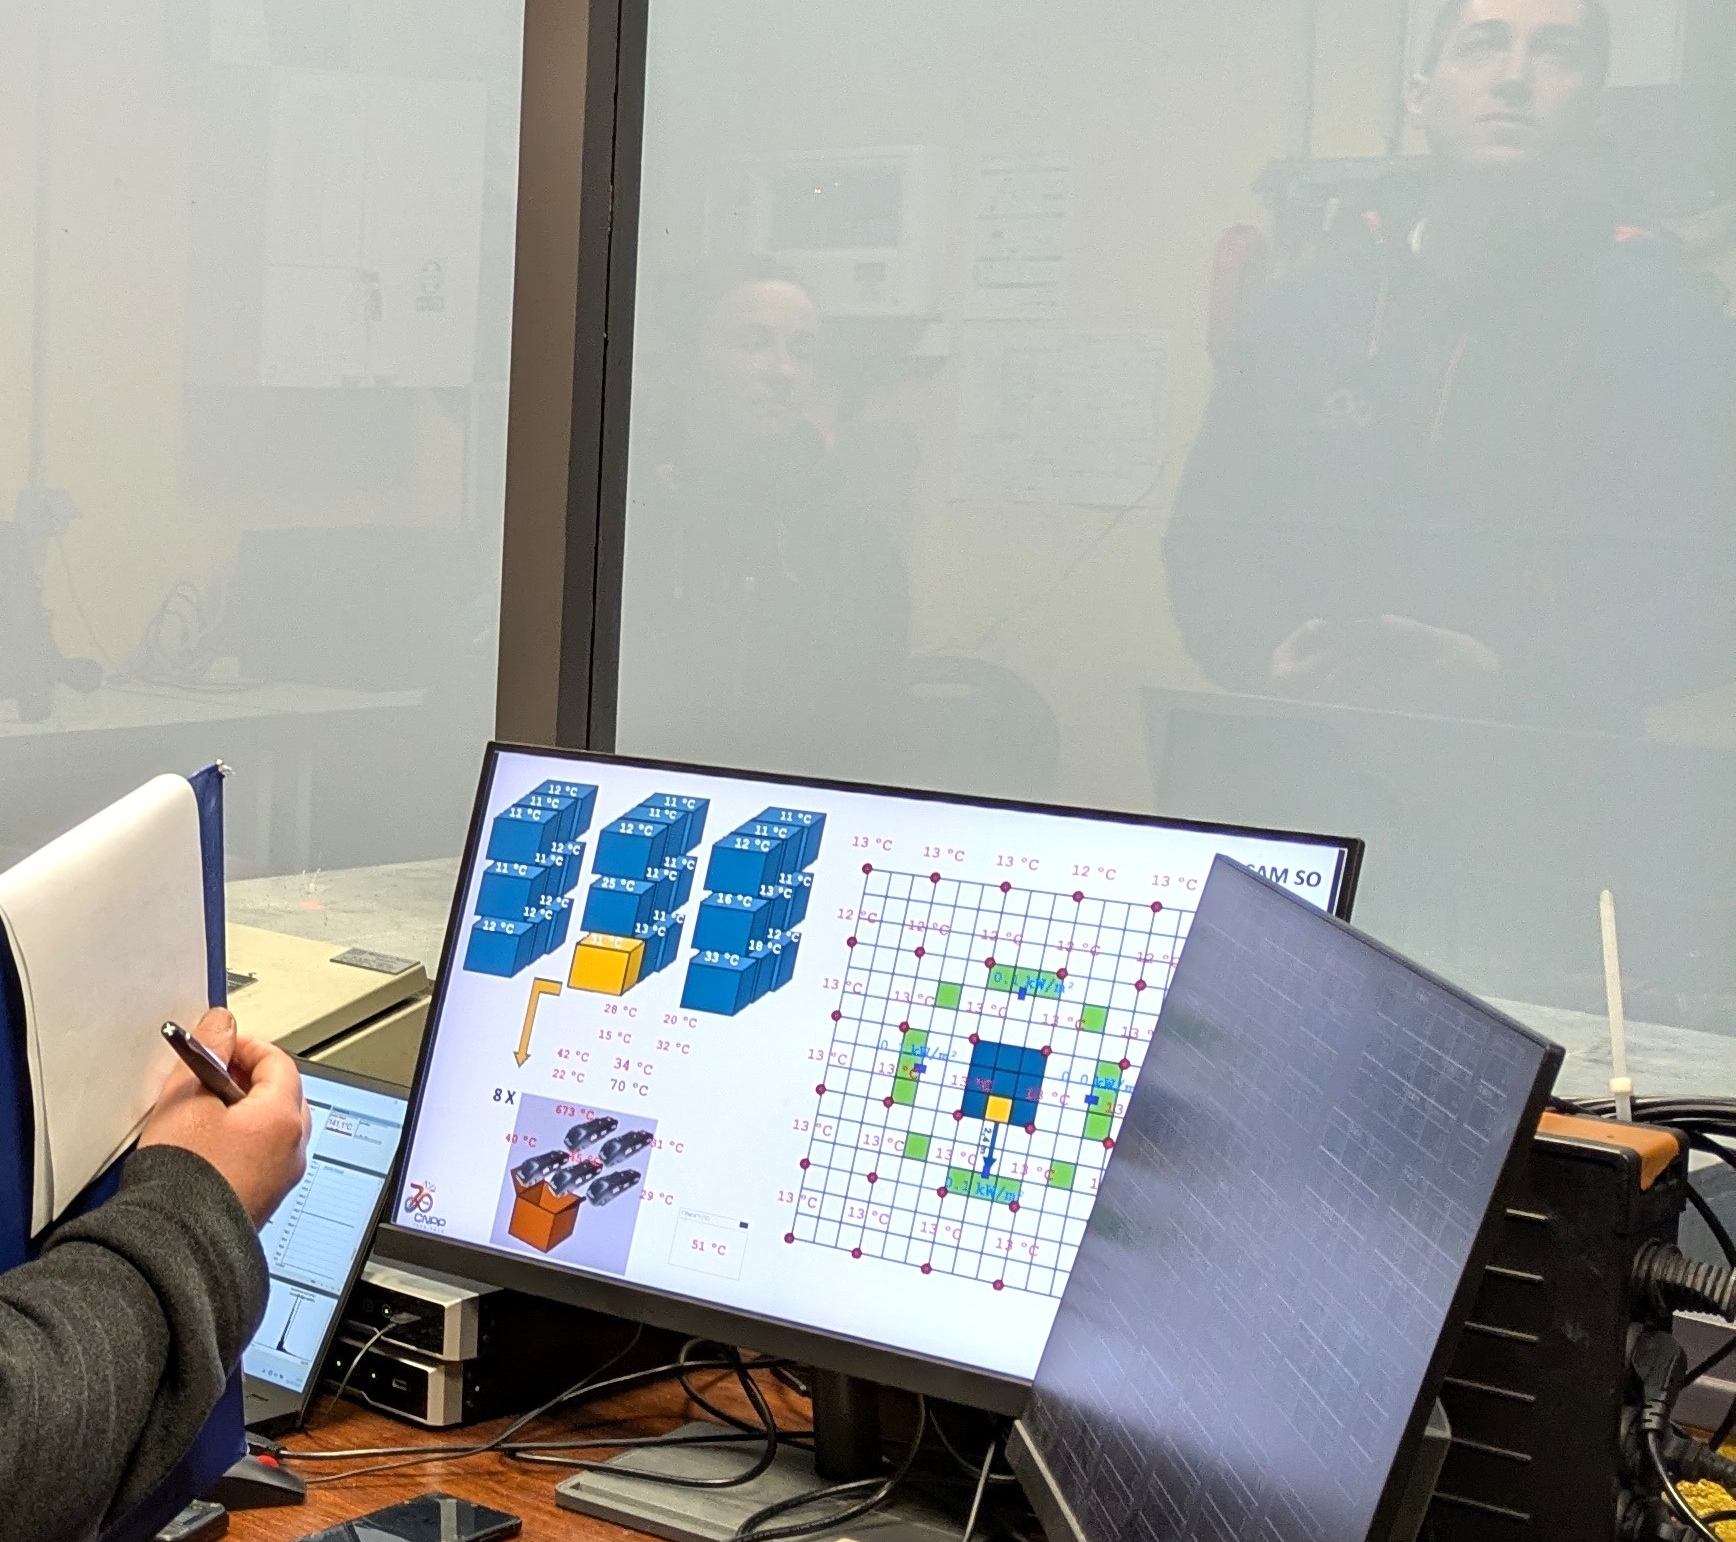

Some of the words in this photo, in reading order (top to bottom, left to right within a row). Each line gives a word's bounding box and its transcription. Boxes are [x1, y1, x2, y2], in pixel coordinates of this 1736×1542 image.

[620, 823, 633, 833] 12
[735, 838, 749, 848] 12
[853, 836, 869, 848] 13
[924, 847, 940, 858] 13
[997, 855, 1013, 868] 13
[1072, 865, 1090, 877] 12
[602, 878, 616, 888] 25
[1152, 875, 1170, 886] 13
[1294, 870, 1321, 887] SO
[483, 921, 496, 931] 12
[705, 951, 719, 962] 33
[823, 978, 839, 990] 13
[663, 1014, 677, 1025] 20
[599, 1030, 612, 1040] 15
[657, 1041, 670, 1051] 32
[557, 1049, 570, 1059] 42
[808, 1049, 824, 1061] 13
[614, 1058, 630, 1071] 34
[552, 1069, 566, 1079] 22
[611, 1078, 625, 1092] 70
[493, 1088, 502, 1102] 8
[505, 1090, 516, 1105] X
[793, 1119, 809, 1131] 13
[864, 1134, 880, 1146] 13
[778, 1191, 794, 1203] 13
[692, 1240, 704, 1251] 51
